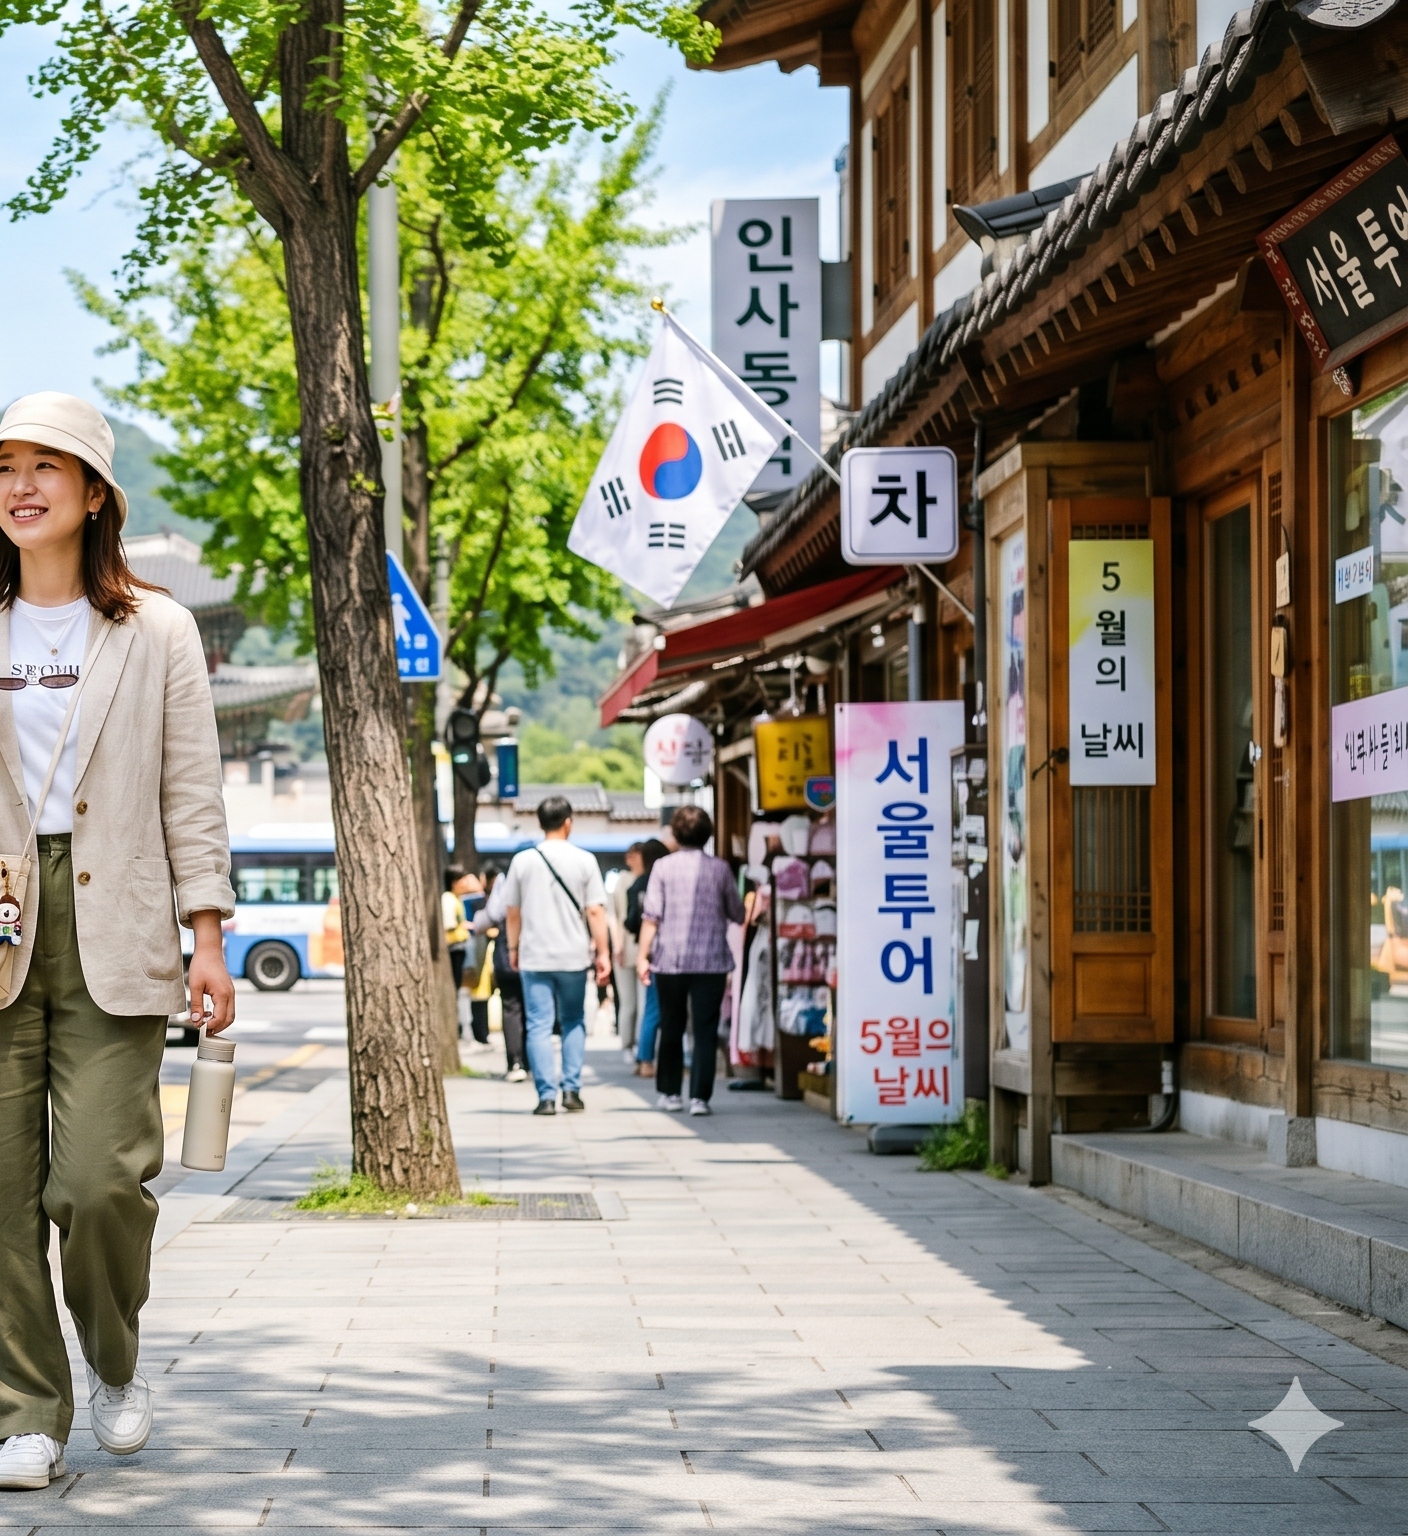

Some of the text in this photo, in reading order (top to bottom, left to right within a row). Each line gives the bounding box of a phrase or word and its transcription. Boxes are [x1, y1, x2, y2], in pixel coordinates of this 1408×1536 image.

[869, 470, 937, 538] 차
[1096, 561, 1126, 692] 5월의
[1081, 722, 1143, 759] 날씨
[875, 736, 936, 995] 서울투어
[873, 1066, 951, 1106] 날씨
